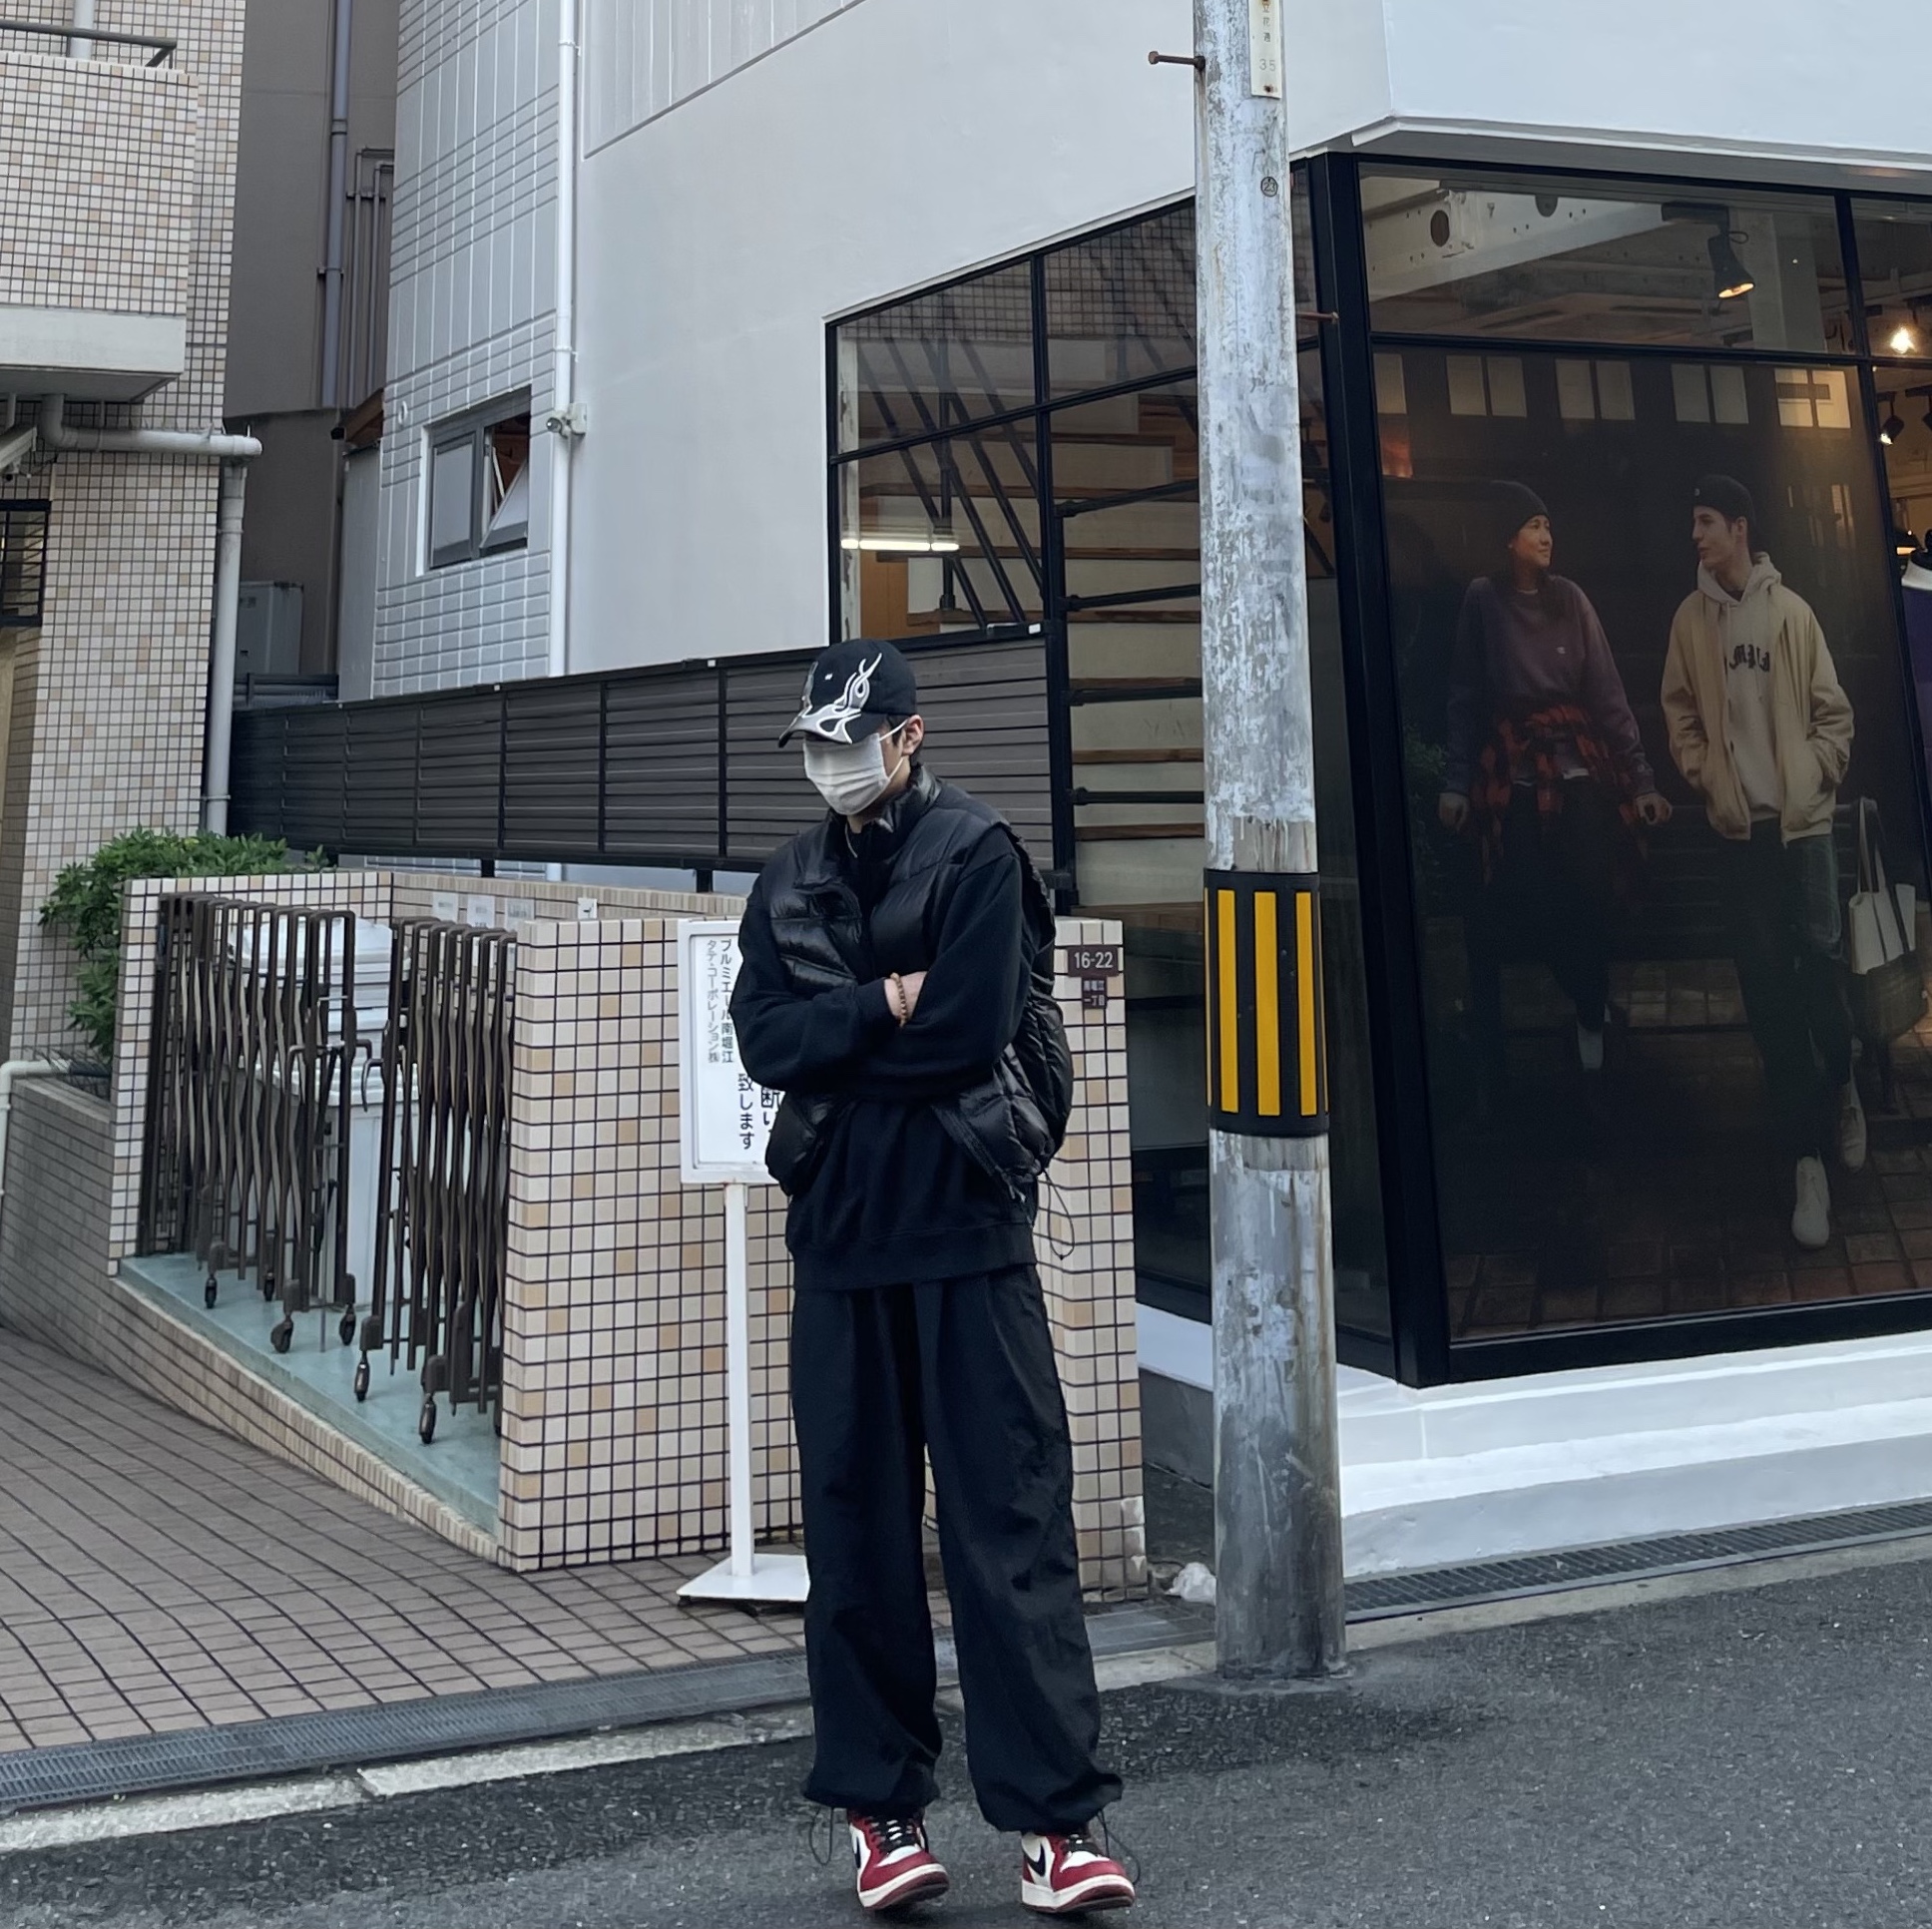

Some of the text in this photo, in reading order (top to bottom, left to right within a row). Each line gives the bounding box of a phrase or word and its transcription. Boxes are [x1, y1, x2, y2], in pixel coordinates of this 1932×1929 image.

[1258, 58, 1276, 72] 35
[1075, 951, 1114, 969] 16-22
[737, 1073, 755, 1151] 致します
